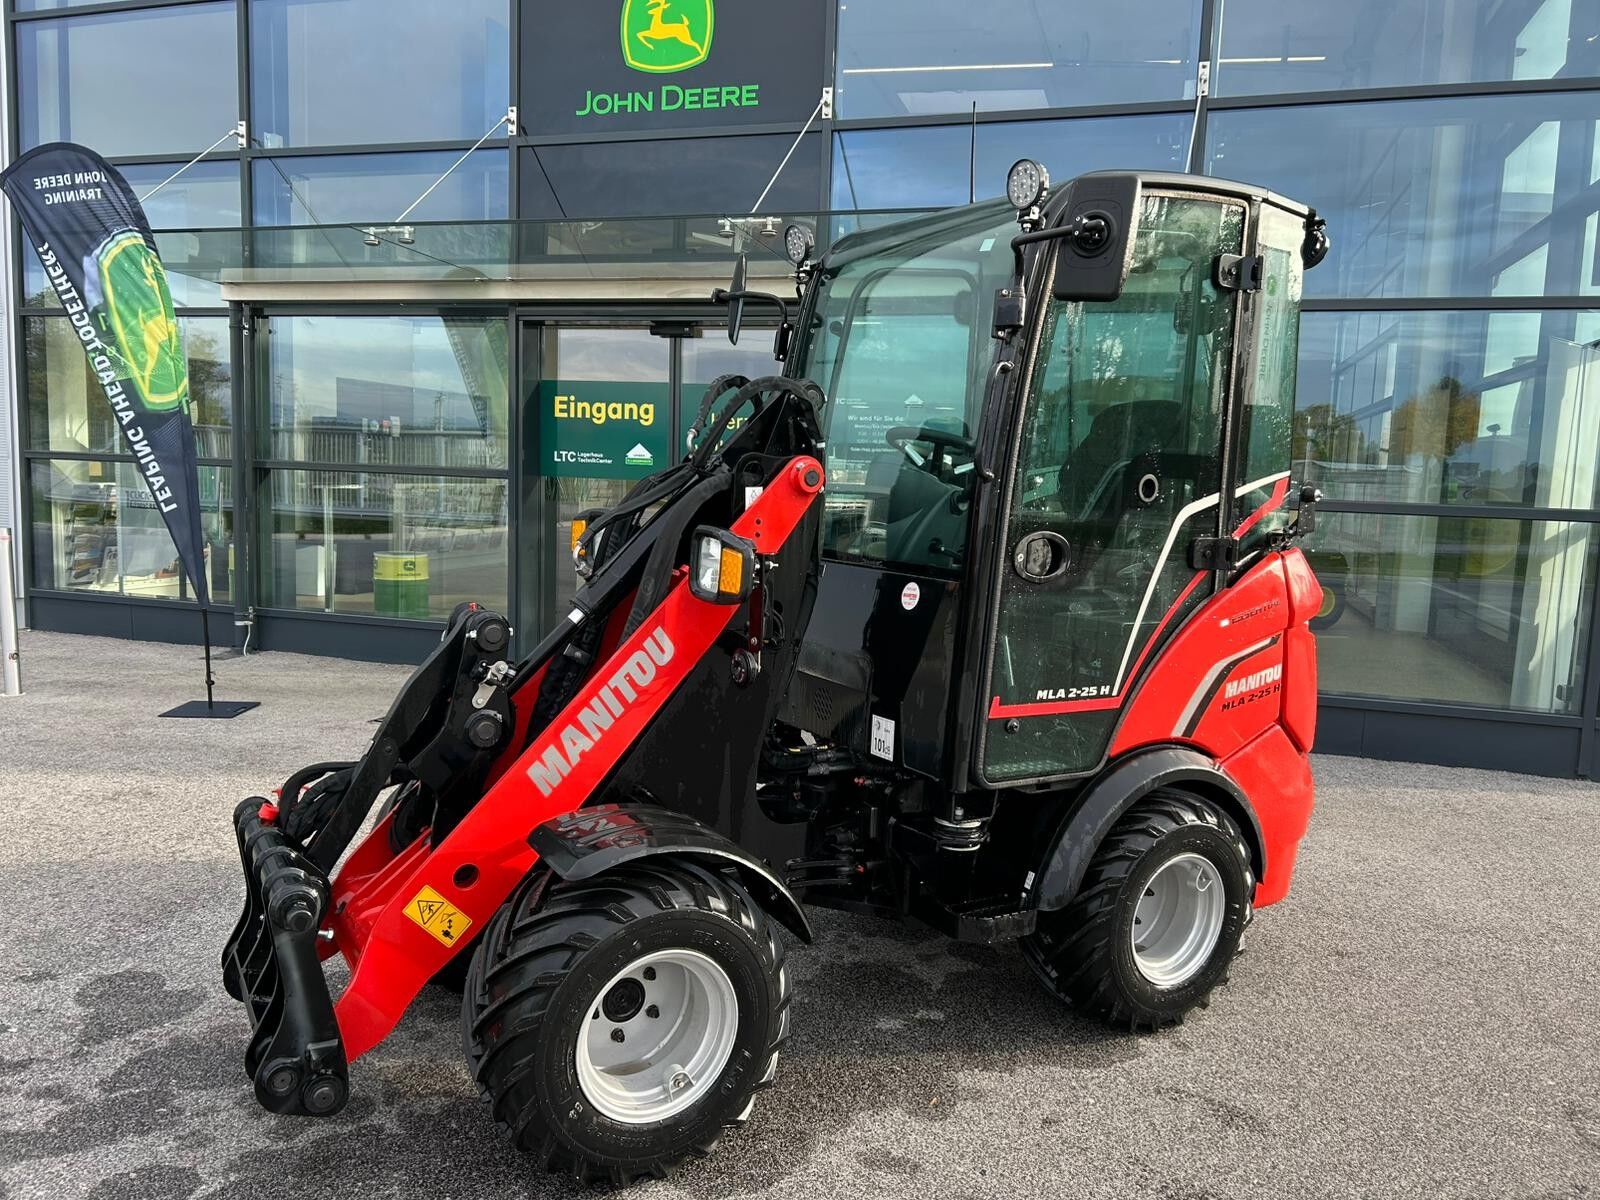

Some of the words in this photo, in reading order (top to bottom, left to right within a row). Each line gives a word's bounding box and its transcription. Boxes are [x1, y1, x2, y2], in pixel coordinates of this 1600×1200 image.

[575, 90, 654, 116] JOHN
[661, 84, 759, 111] DEERE
[554, 395, 654, 426] Eingang
[553, 450, 577, 463] LTC
[1036, 688, 1066, 700] MLA
[1068, 686, 1098, 698] 2-25
[1100, 685, 1111, 695] H
[1224, 663, 1282, 699] MANITOU
[525, 625, 675, 797] MANITOU
[1221, 696, 1245, 713] MLA
[1247, 687, 1271, 704] 2-25
[1273, 683, 1281, 693] H
